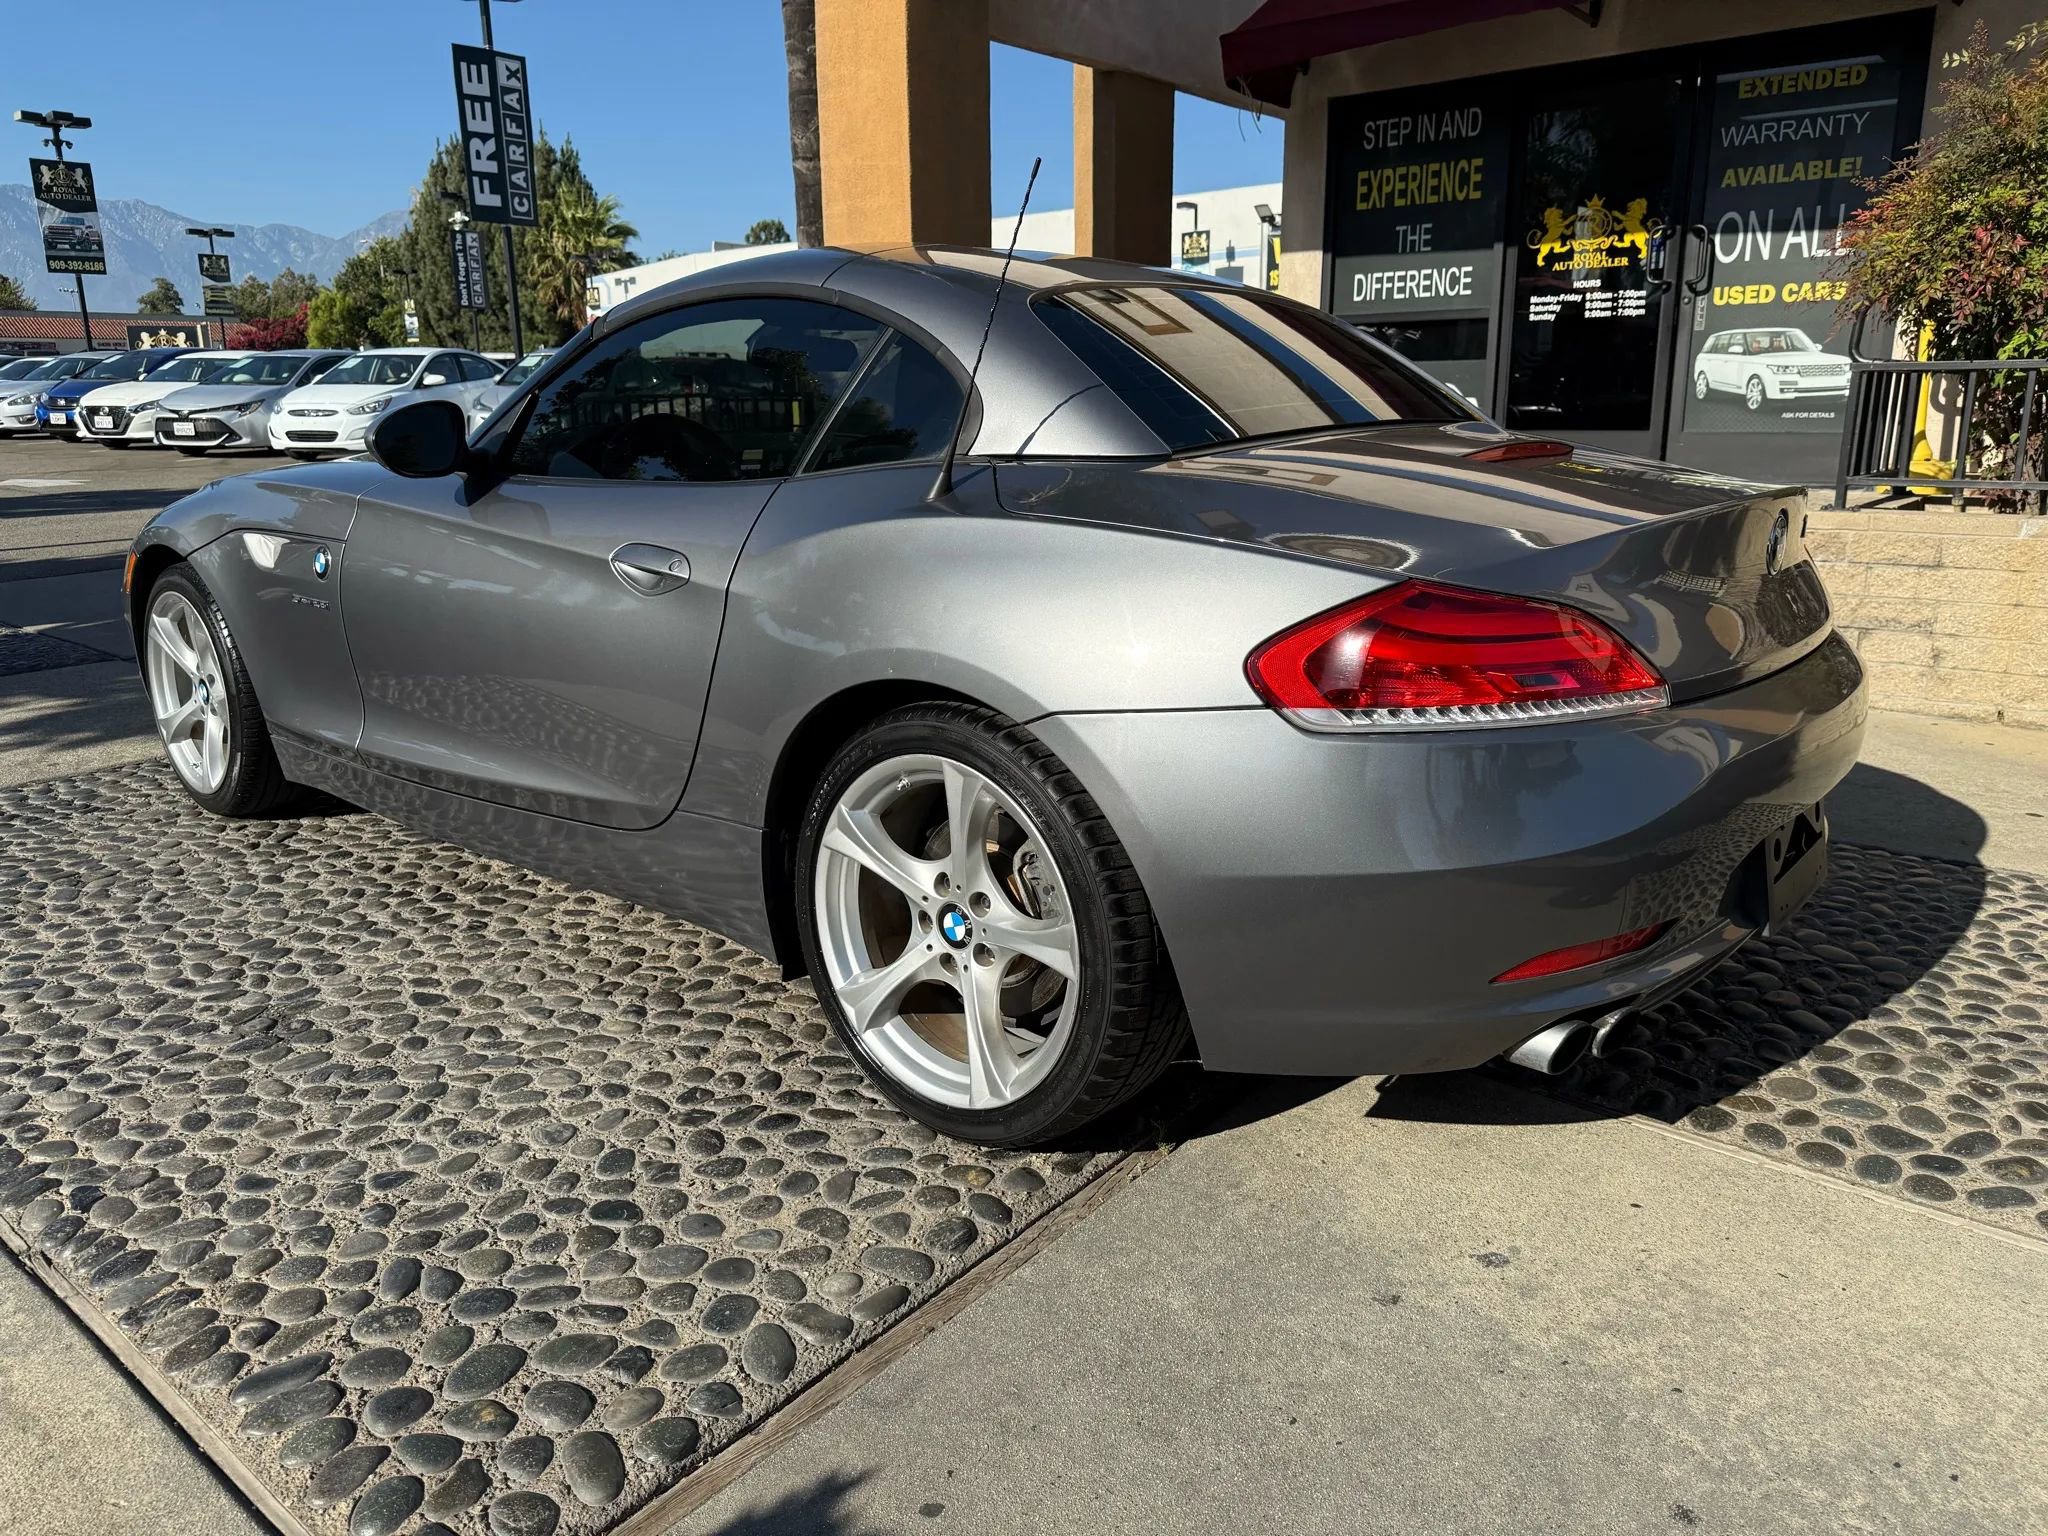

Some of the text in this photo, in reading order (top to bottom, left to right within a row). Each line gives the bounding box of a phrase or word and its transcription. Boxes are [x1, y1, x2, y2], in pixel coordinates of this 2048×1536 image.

[1737, 64, 1868, 99] EXTENDED
[459, 61, 503, 208] FREE
[503, 62, 530, 214] CARFAX
[1363, 107, 1482, 150] STEP IN AND
[1720, 112, 1871, 148] WARRANTY
[1356, 158, 1484, 211] EXPERIENCE
[1720, 156, 1864, 188] AVAILABLE!
[40, 191, 92, 201] AUTO DEALER
[53, 186, 77, 194] ROYAL
[1396, 223, 1433, 254] THE
[1714, 208, 1775, 264] ON
[1780, 203, 1856, 260] ALL
[49, 260, 104, 271] 909-392-8186
[455, 233, 469, 306] Don't Forget The
[469, 235, 483, 304] CARFAX
[1552, 257, 1629, 271] AUTO DEALER
[1573, 251, 1609, 262] ROYAL
[1353, 266, 1473, 302] DIFFERENCE
[1530, 293, 1583, 304] Monday-Friday
[1585, 291, 1613, 300] 9:00am
[1618, 290, 1647, 299] 7:00pm
[1573, 279, 1602, 288] HOURS
[1713, 281, 1848, 306] USED CARS
[1528, 312, 1556, 322] Sunday
[1584, 310, 1612, 318] 9:00am
[1617, 308, 1646, 317] 7:00pm
[1529, 303, 1561, 313] Saturday
[1585, 301, 1612, 309] 9:00am
[1618, 299, 1646, 308] 7:00pm
